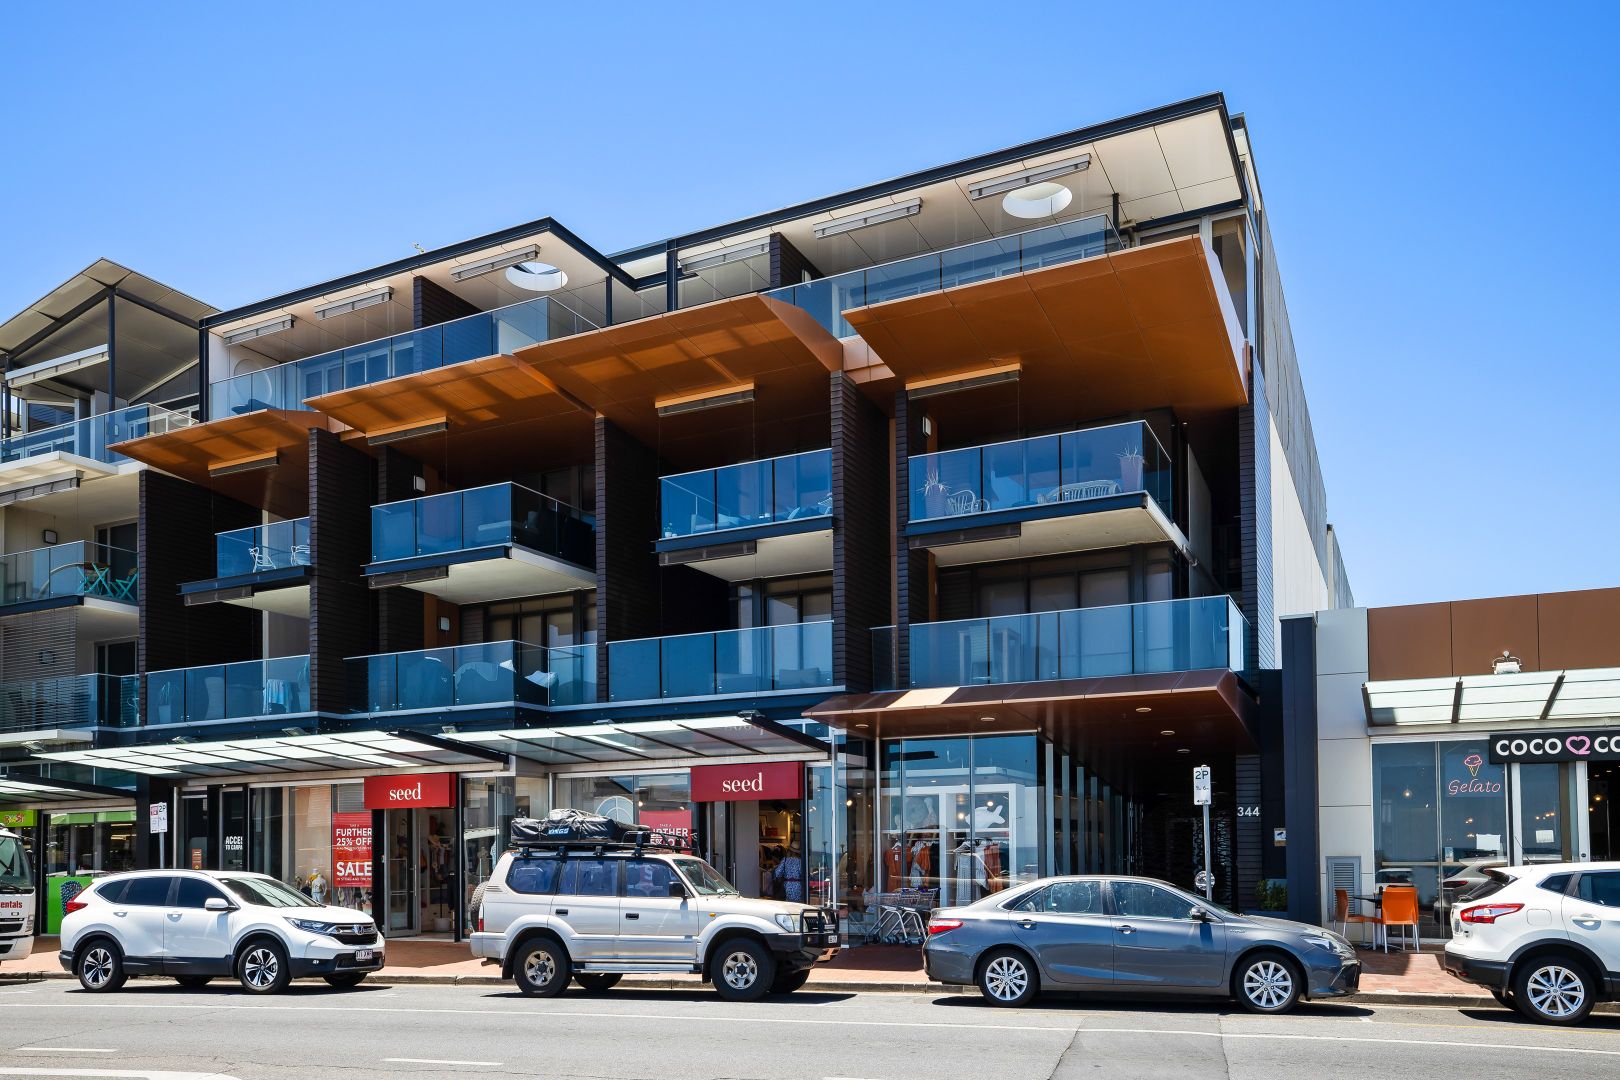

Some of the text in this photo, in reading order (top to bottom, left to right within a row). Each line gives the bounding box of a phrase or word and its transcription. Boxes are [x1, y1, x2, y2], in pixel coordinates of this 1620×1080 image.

[1496, 738, 1562, 756] COCO
[722, 771, 763, 792] seed
[1195, 770, 1209, 780] 2P
[390, 782, 422, 800] seed
[1448, 779, 1501, 795] Gelato
[1237, 806, 1260, 817] 344
[336, 828, 372, 837] FURTHER
[336, 837, 372, 846] 25% OFF
[336, 861, 372, 877] SALE
